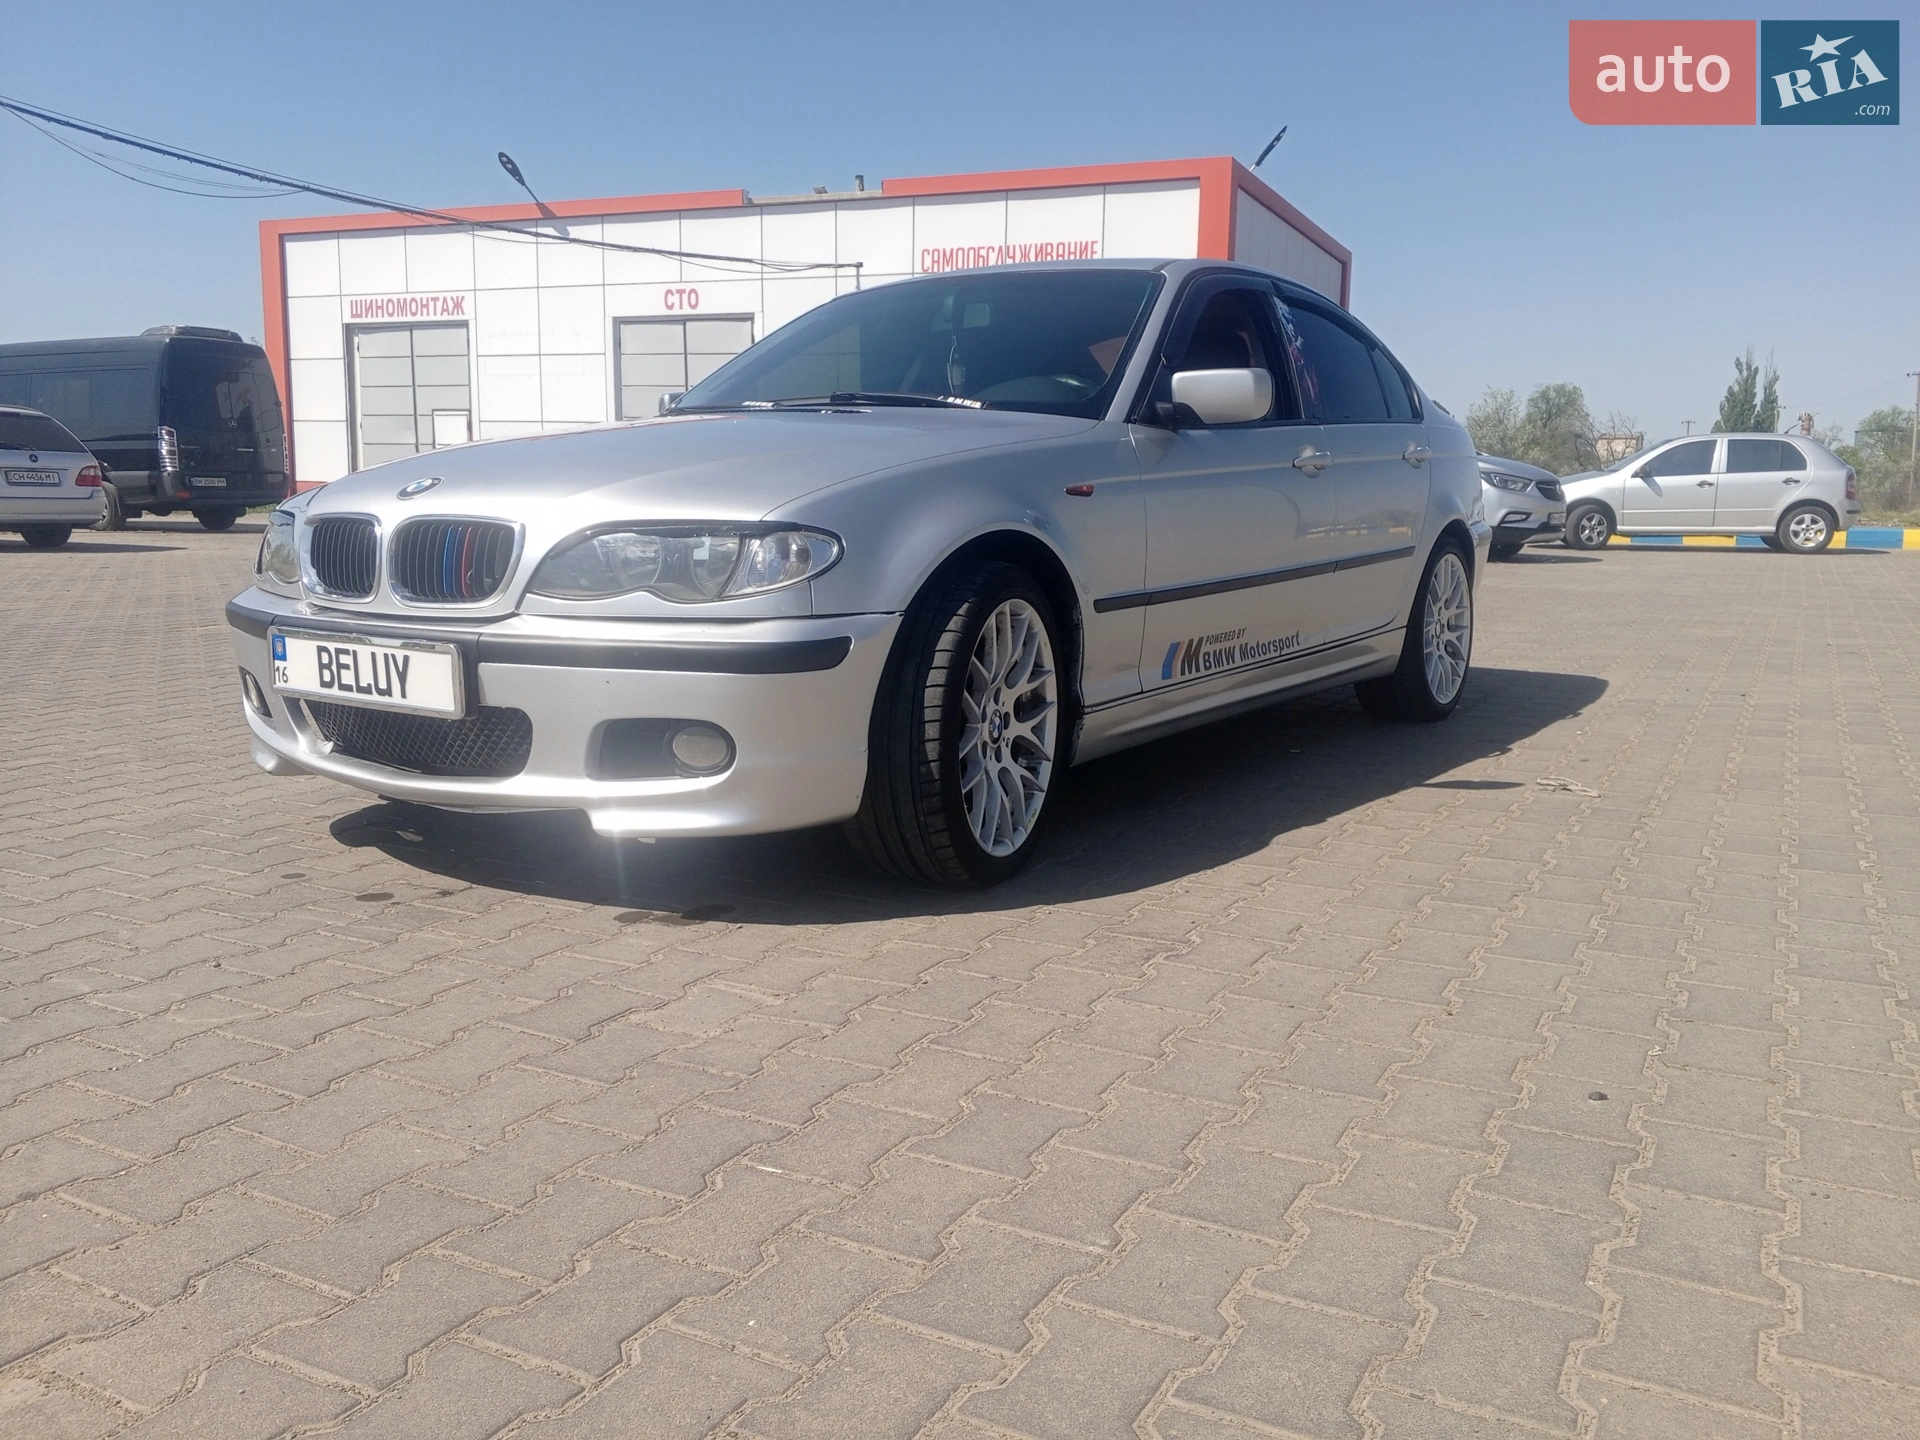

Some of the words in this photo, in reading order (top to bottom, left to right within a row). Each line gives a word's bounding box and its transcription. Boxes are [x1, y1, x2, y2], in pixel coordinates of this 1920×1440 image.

[350, 295, 466, 319] ШИНОМОНТАЖ
[664, 288, 699, 311] СТО
[1204, 630, 1236, 646] POWERED
[1236, 627, 1247, 640] BY
[1180, 636, 1204, 676] M
[1202, 645, 1236, 671] BMW
[1239, 630, 1301, 663] Motorsport
[275, 665, 289, 683] 16
[316, 645, 410, 699] BELUY
